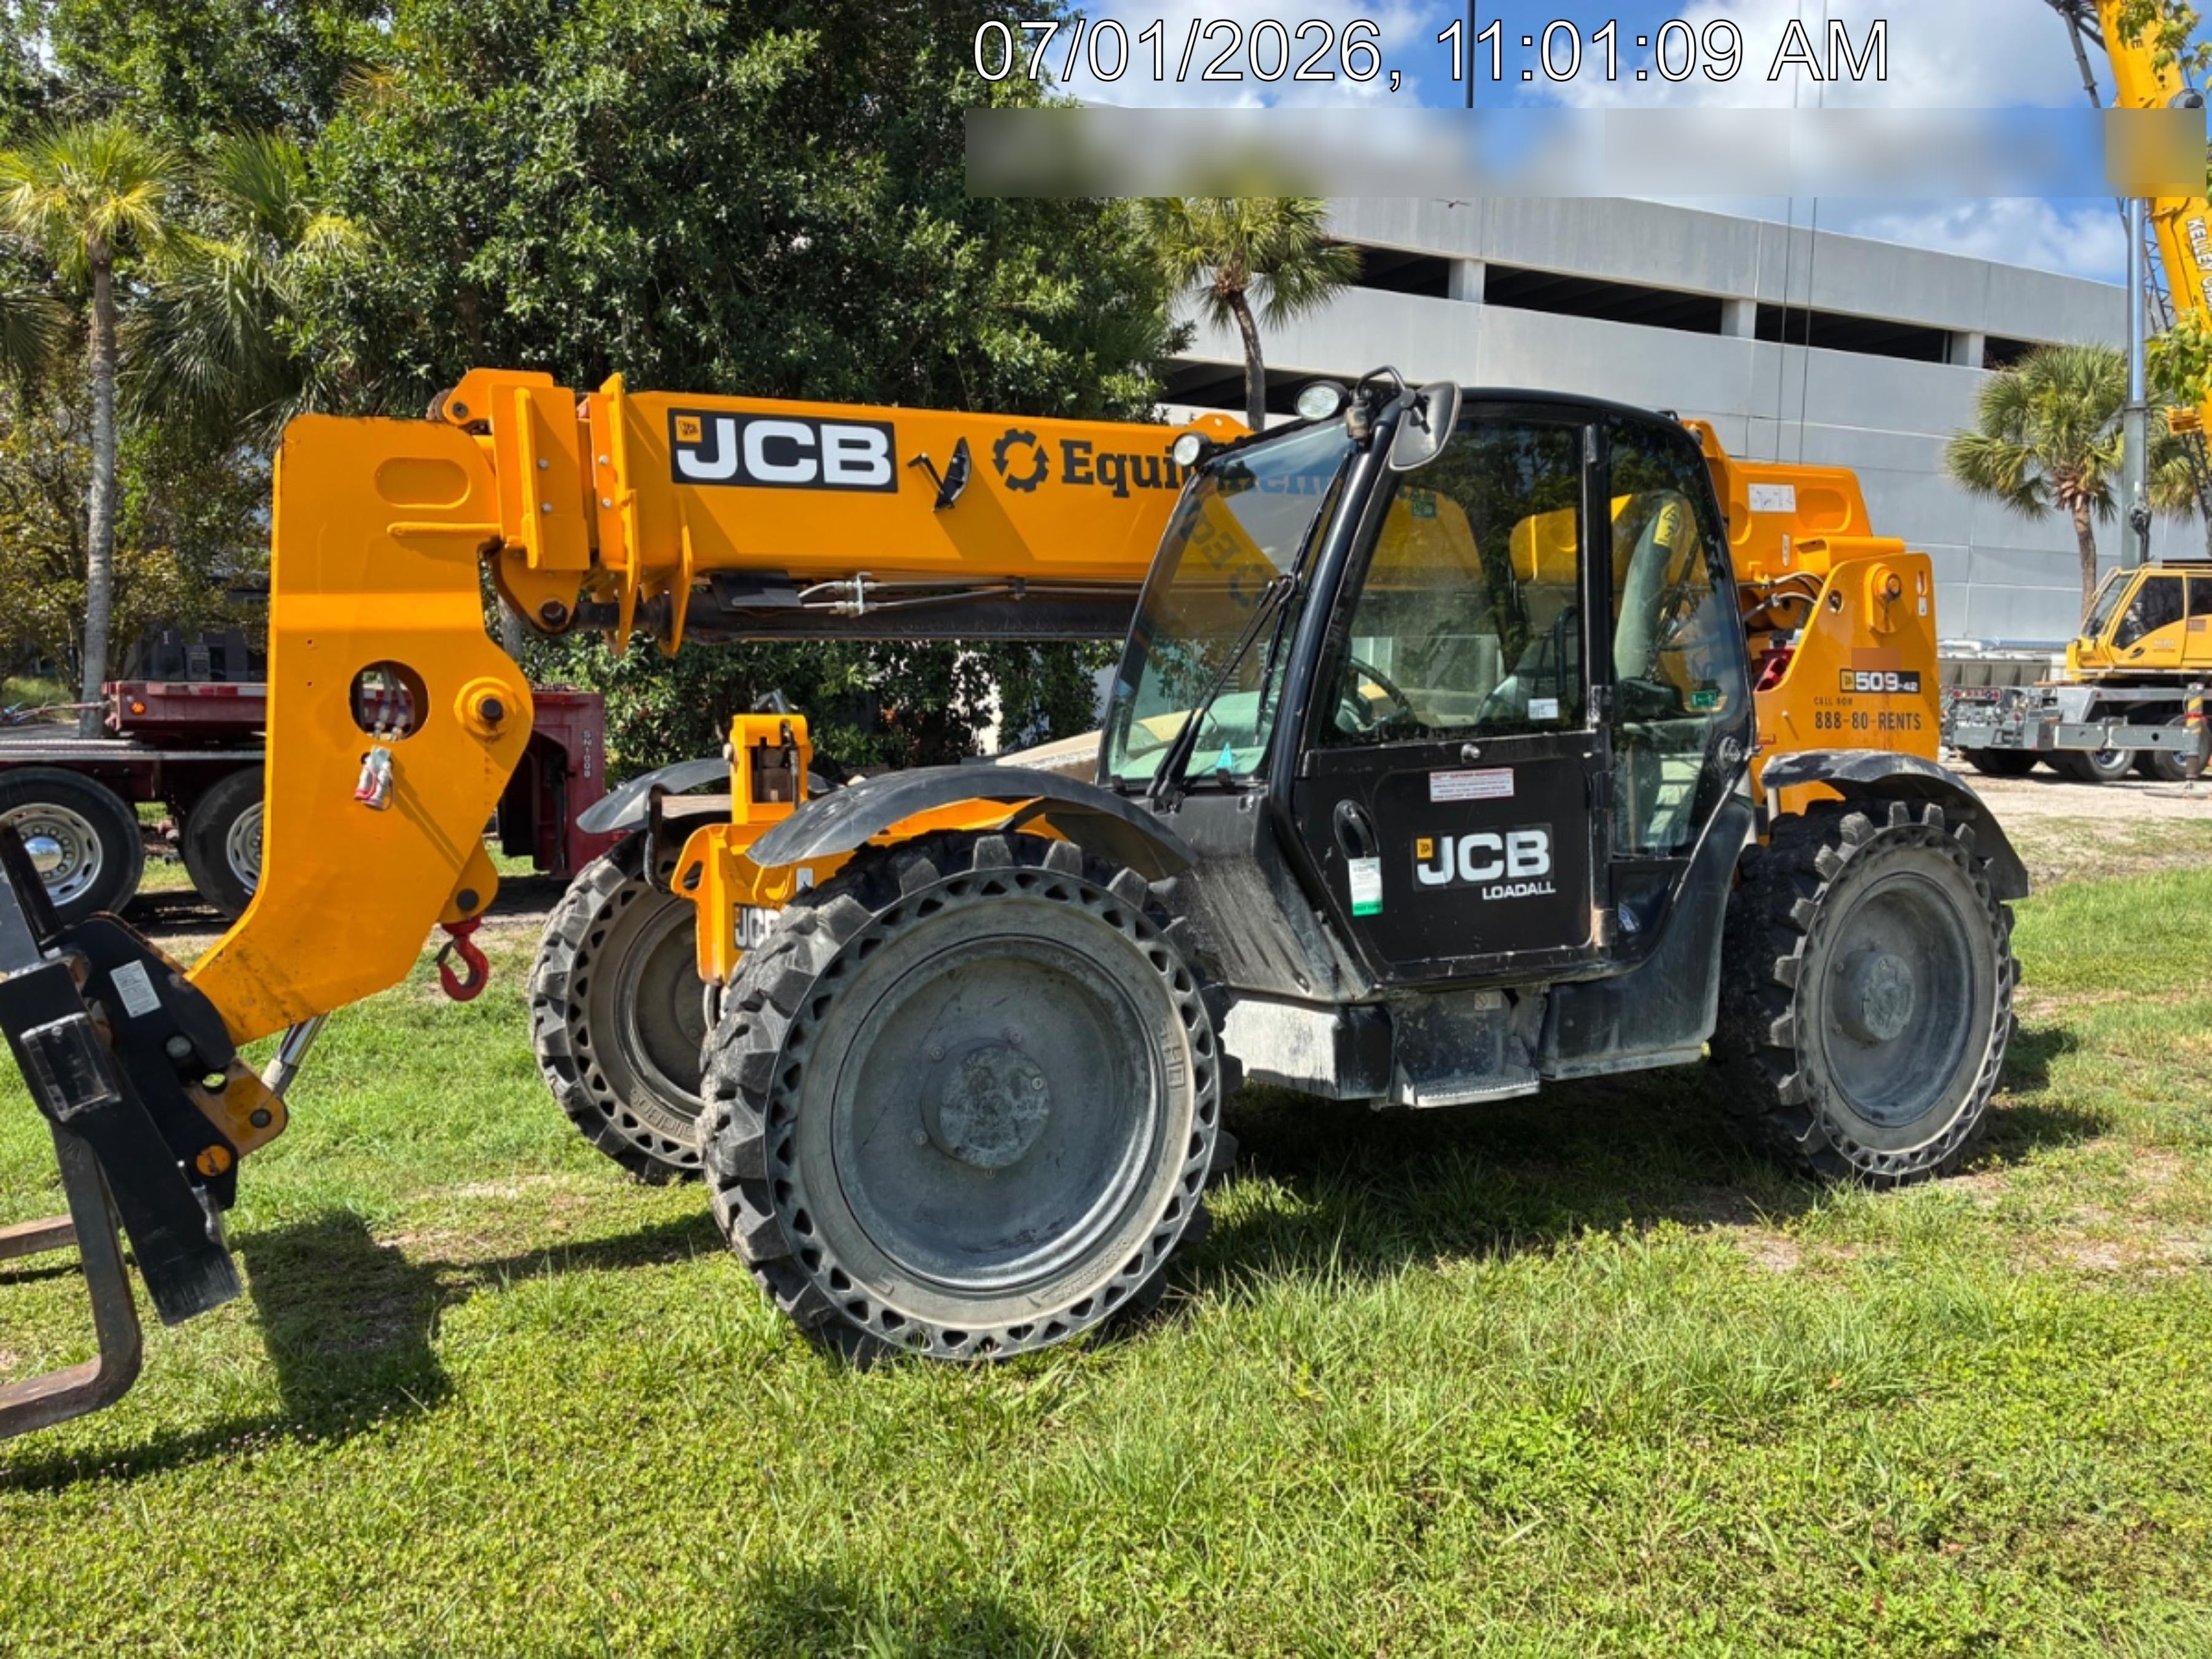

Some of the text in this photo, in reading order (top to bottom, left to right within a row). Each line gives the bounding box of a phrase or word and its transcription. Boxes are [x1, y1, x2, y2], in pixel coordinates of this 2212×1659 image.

[677, 418, 892, 486] JCB
[1814, 696, 1832, 706] CALL
[1815, 711, 1921, 730] 888-80-RENTS
[1417, 830, 1550, 886] JCB
[1481, 880, 1556, 900] LOADALL
